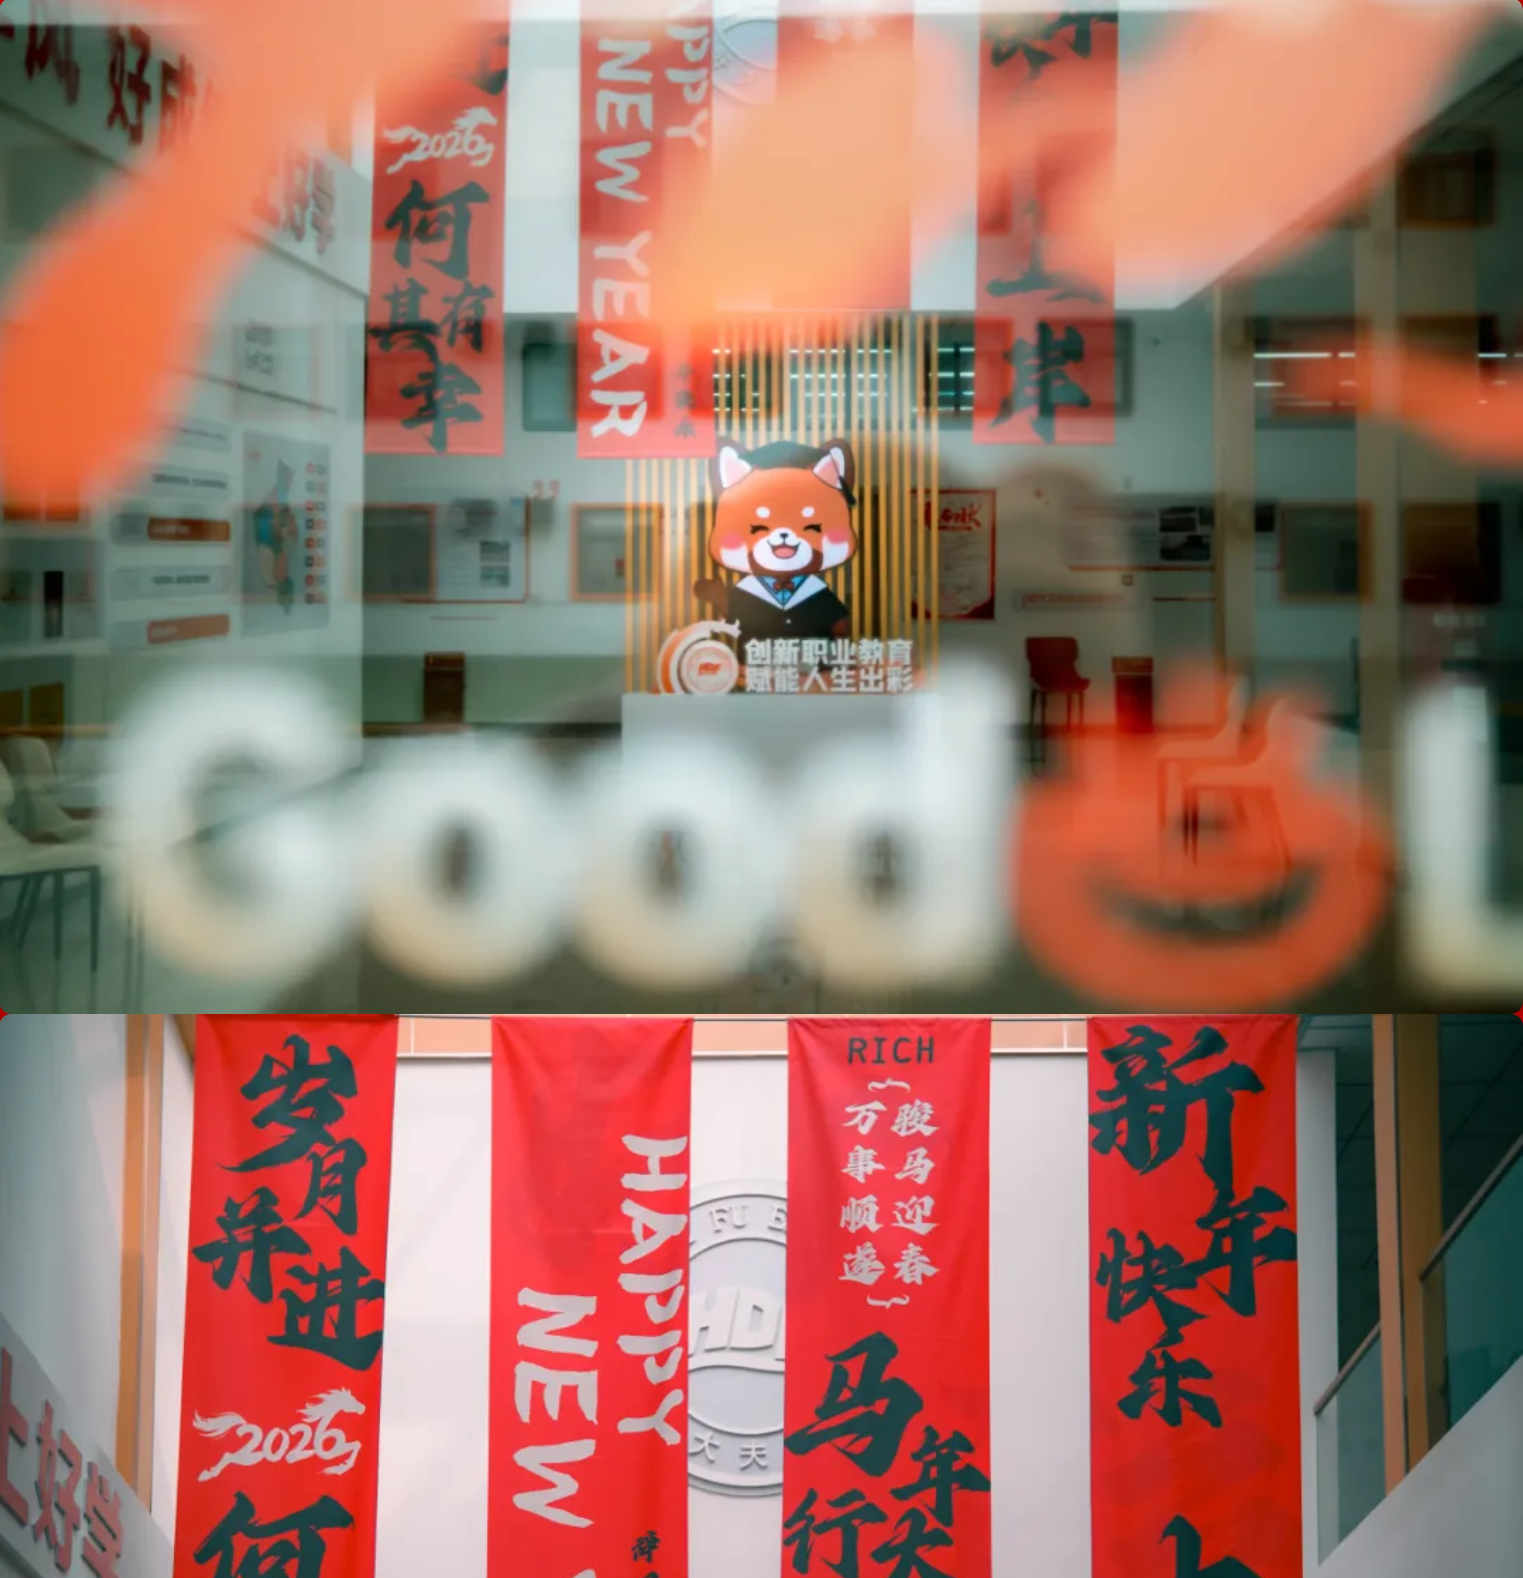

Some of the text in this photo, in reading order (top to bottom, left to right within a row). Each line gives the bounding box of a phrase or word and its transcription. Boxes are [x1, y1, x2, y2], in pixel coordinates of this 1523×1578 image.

[664, 0, 710, 149] PPY
[368, 179, 493, 452] 何其有幸
[590, 38, 653, 438] NEW YEAR
[745, 638, 913, 666] 创新职业教育
[745, 667, 913, 693] 赋能人生出彩
[110, 660, 1010, 988] Good
[846, 1037, 935, 1065] RICH
[192, 1034, 386, 1371] 岁月并进
[617, 1134, 688, 1446] HAPPY
[837, 1100, 886, 1287] 万事顺遂
[889, 1098, 938, 1286] 骏马迎春
[1088, 1026, 1298, 1428] 新年快乐
[512, 1287, 598, 1530] NEW
[688, 1431, 769, 1471] 大夫
